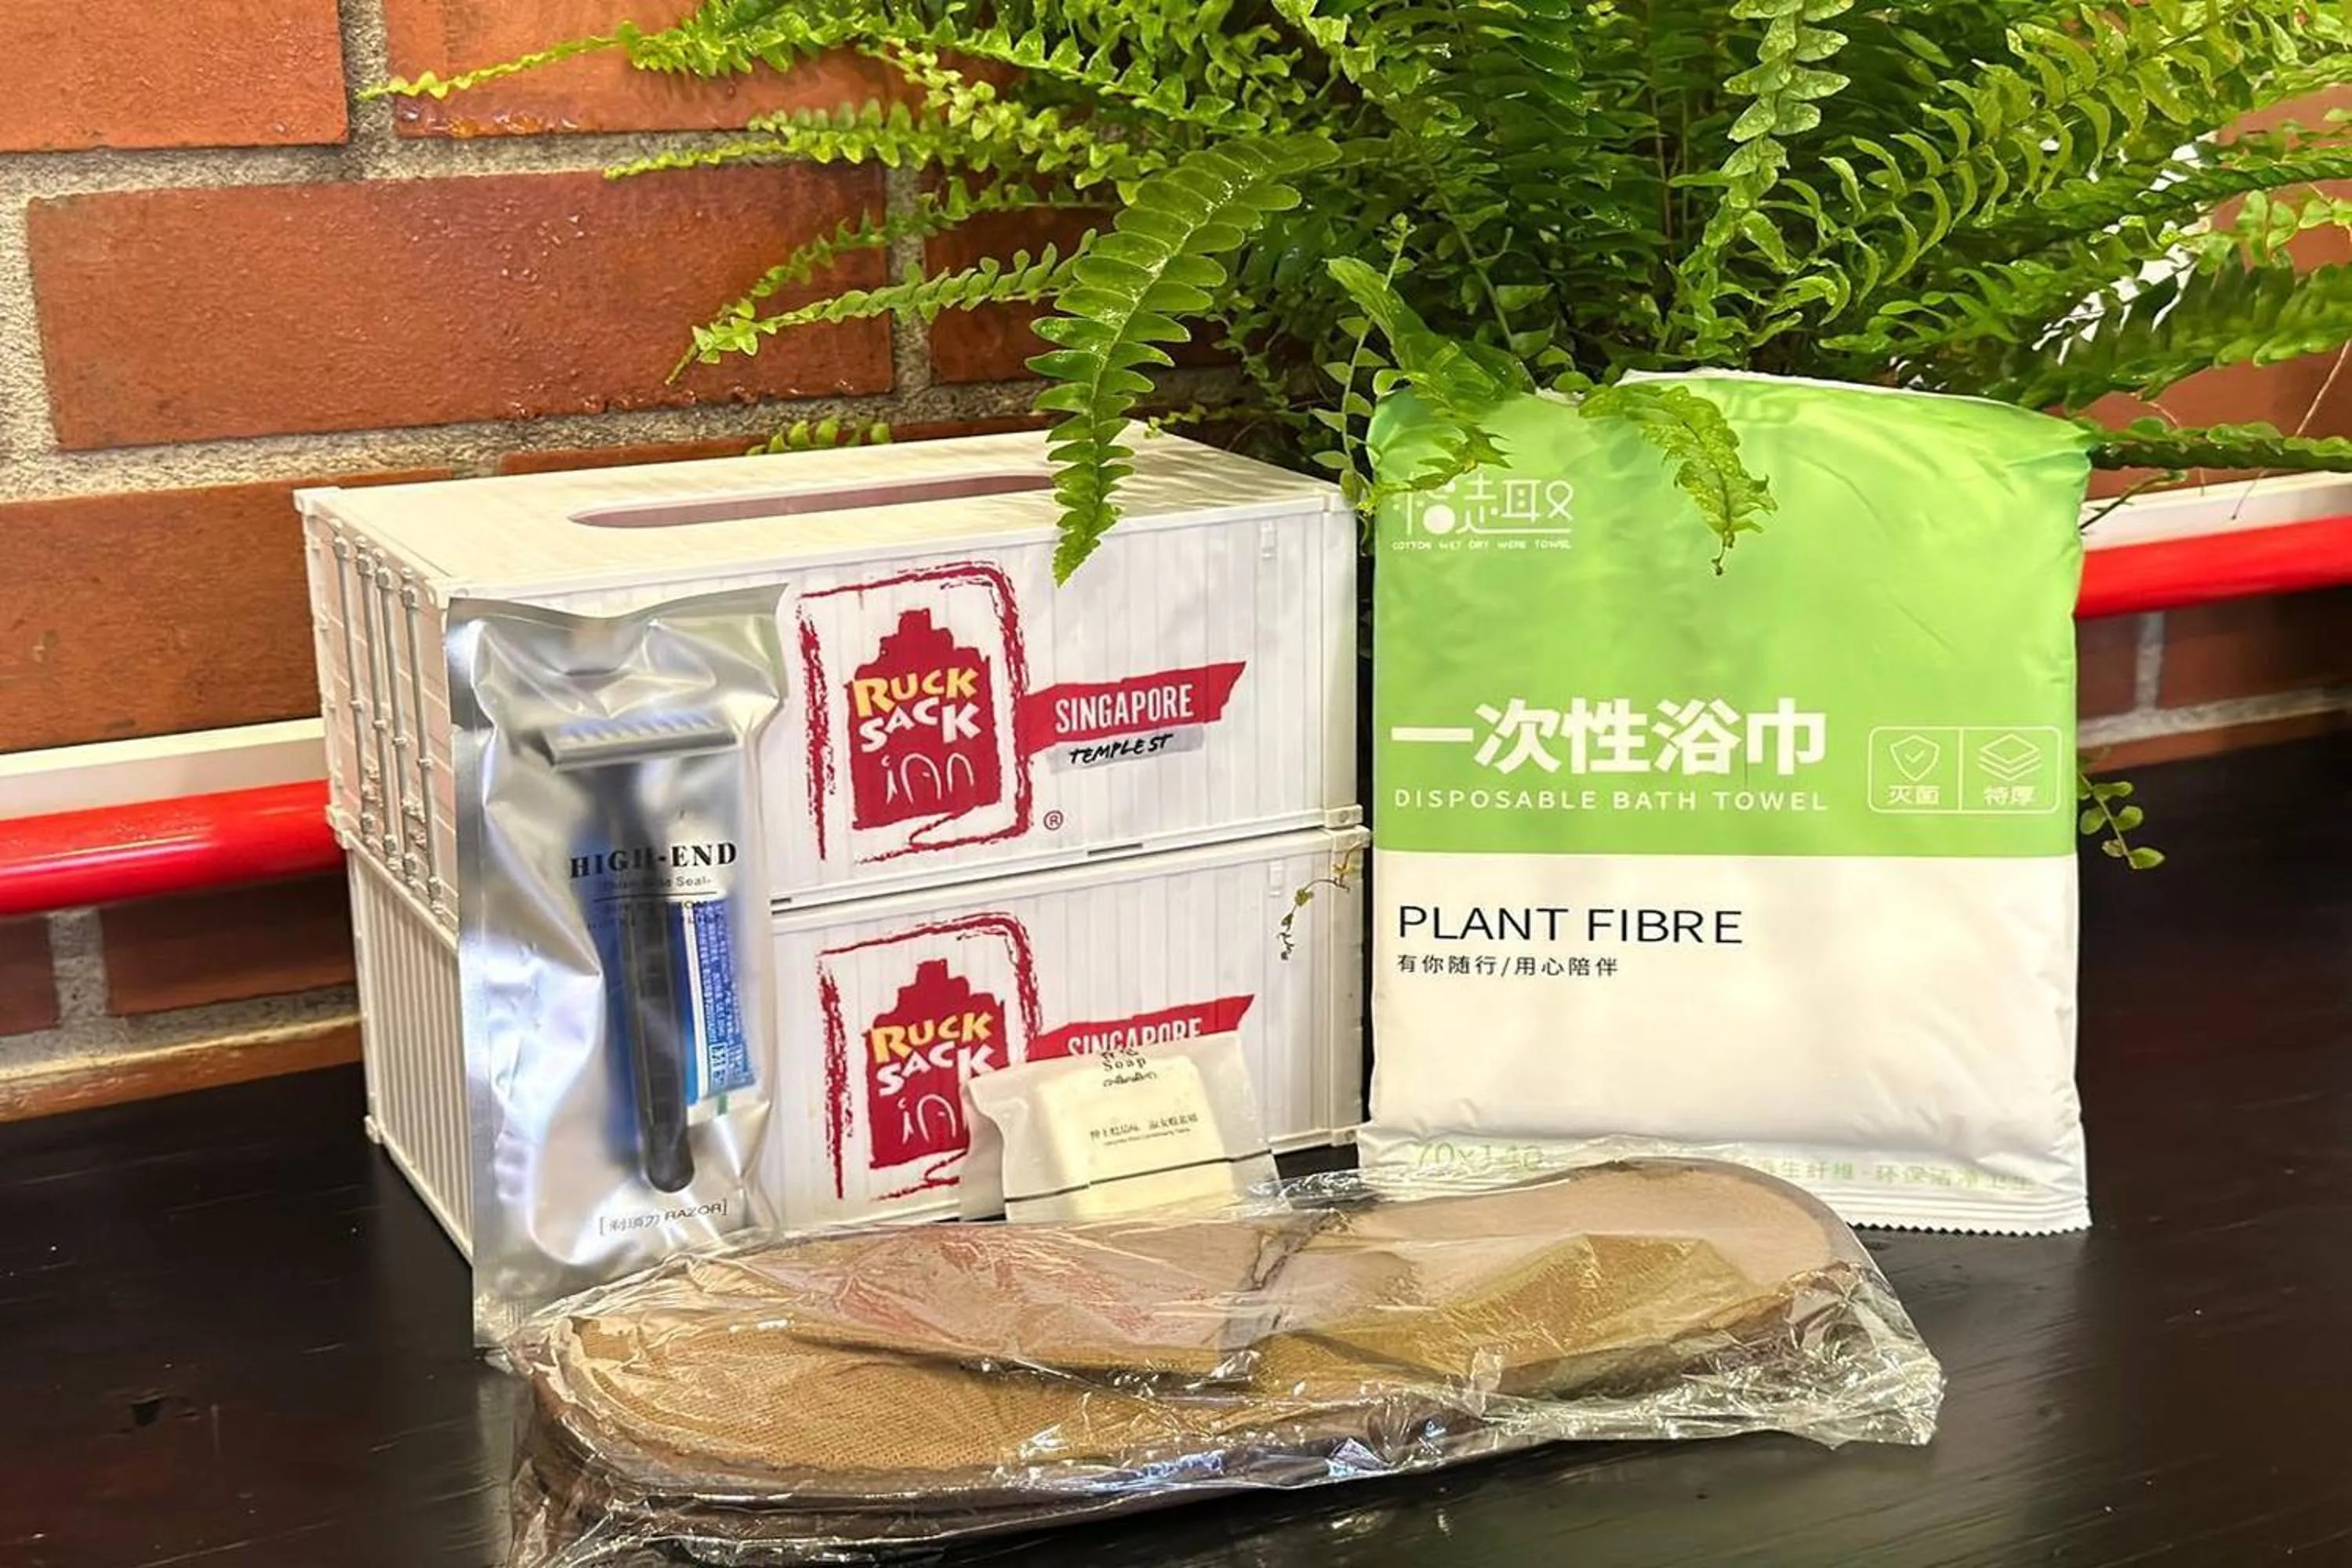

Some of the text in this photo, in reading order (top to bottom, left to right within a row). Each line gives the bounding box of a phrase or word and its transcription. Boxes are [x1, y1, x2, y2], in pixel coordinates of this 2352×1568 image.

[853, 667, 979, 718] RUCK
[1054, 684, 1194, 734] SINGAPORE
[859, 696, 981, 753] SACK
[1391, 697, 1828, 775] 一次性浴巾
[1069, 733, 1174, 764] TEMPLE ST
[1394, 789, 1829, 811] DISPOSABLE BATH TOWEL
[570, 841, 737, 879] HIGH-END
[1399, 906, 1744, 943] PLANT FIBRE
[1397, 953, 1619, 977] 有你随行/用心陪伴
[871, 1012, 993, 1065] RUCK
